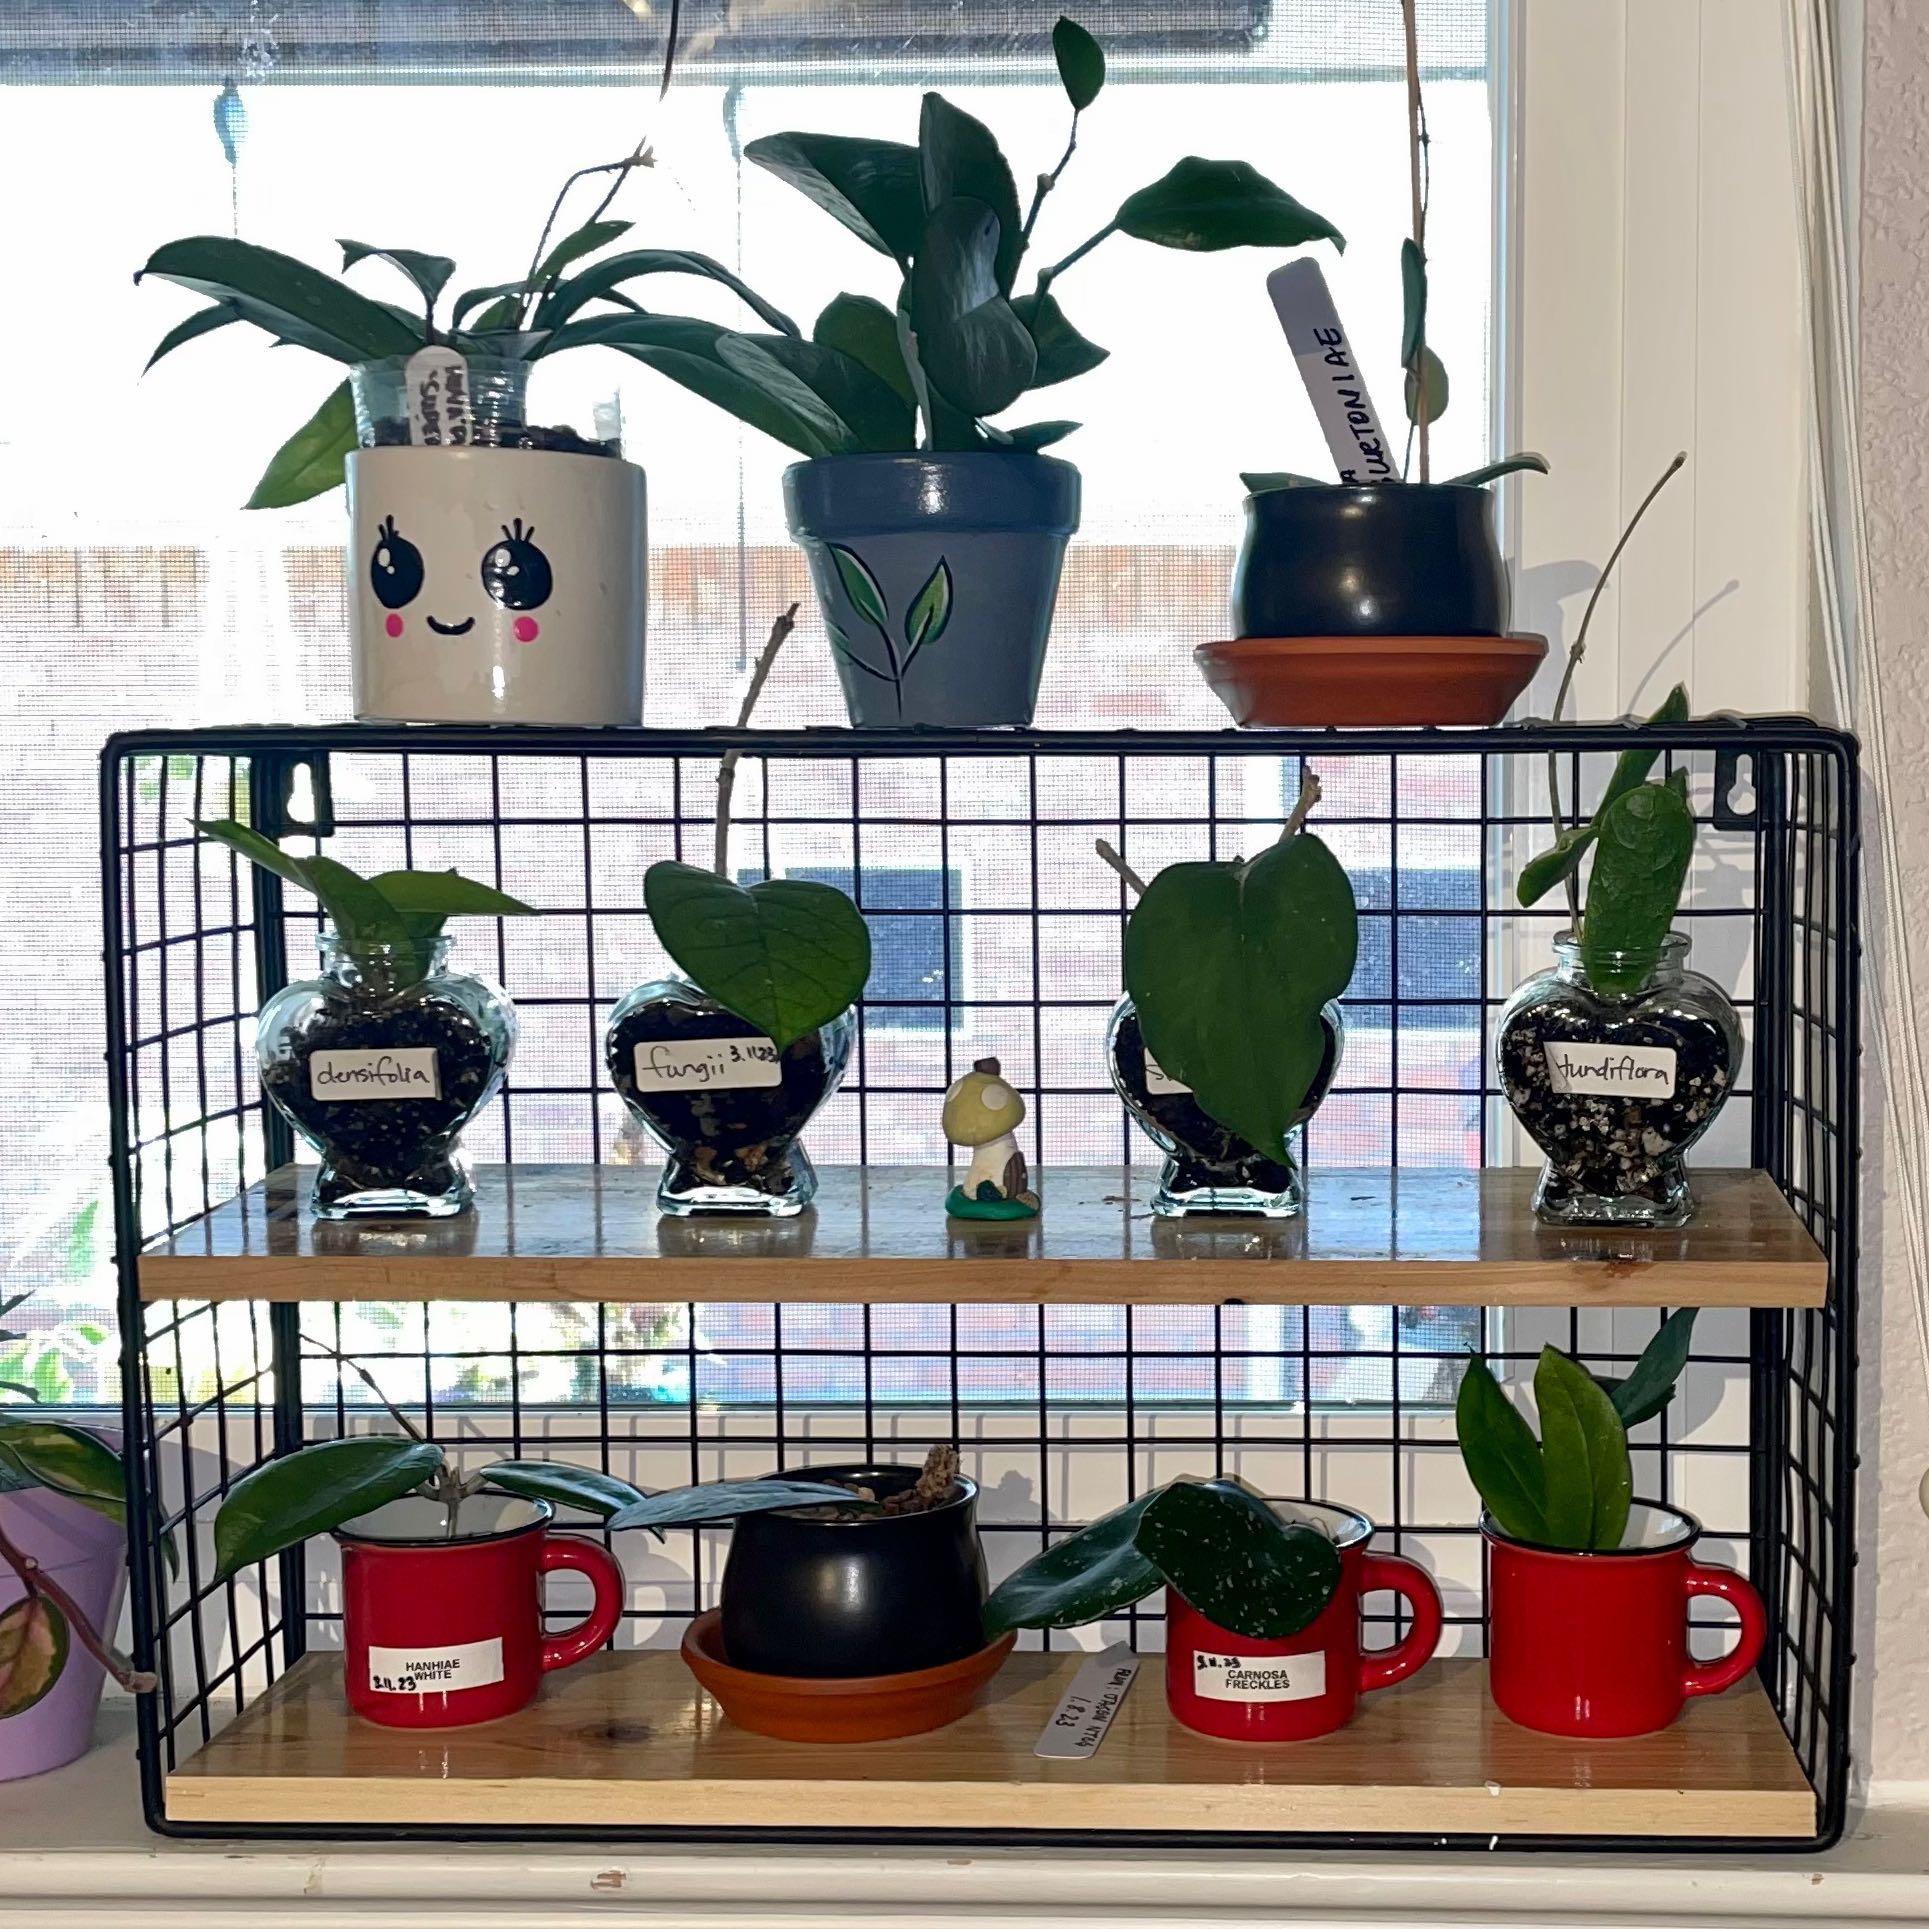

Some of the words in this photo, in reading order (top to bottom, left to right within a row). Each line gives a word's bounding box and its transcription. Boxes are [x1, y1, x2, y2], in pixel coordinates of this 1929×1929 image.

[1313, 328, 1395, 484] URTONIAE
[317, 1056, 430, 1085] densifolia
[640, 1045, 725, 1083] fungii
[405, 1658, 460, 1672] HANHIAE
[414, 1669, 452, 1681] WHITE
[1227, 1669, 1288, 1681] CARNOSA
[1225, 1679, 1290, 1690] FRECKLES
